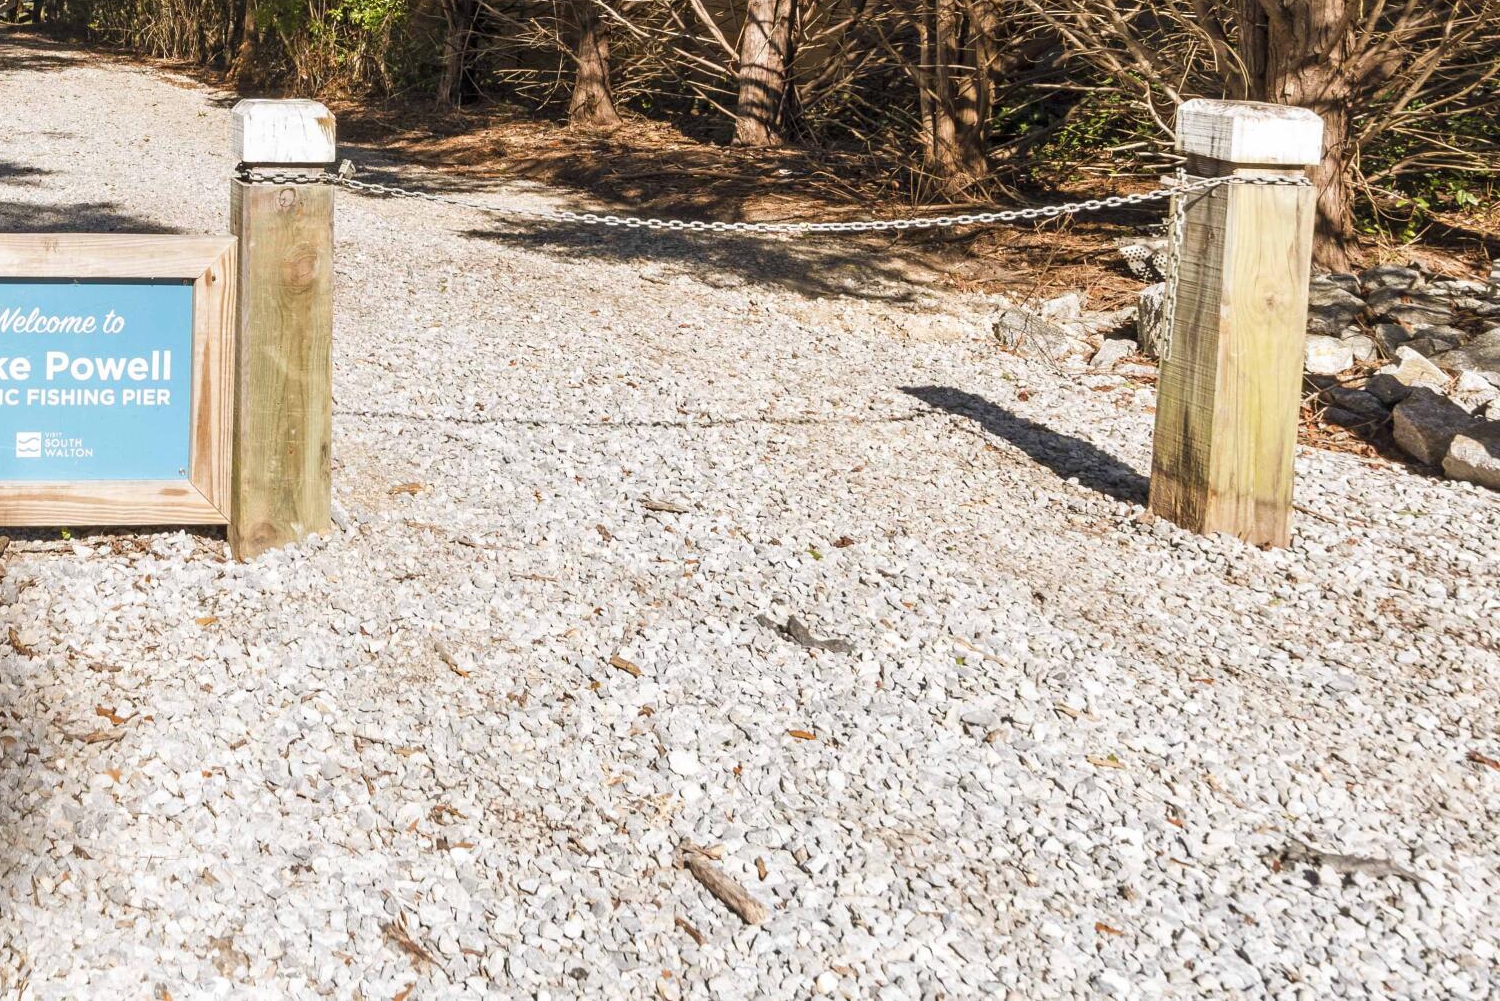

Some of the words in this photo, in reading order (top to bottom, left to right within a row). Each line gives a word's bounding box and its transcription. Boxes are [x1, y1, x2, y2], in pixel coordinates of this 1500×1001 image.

[102, 309, 125, 334] to
[45, 350, 172, 381] Powell
[26, 388, 116, 406] FISHING
[122, 388, 171, 406] PIER
[44, 438, 82, 448] SOUTH
[44, 448, 93, 458] WALTON
